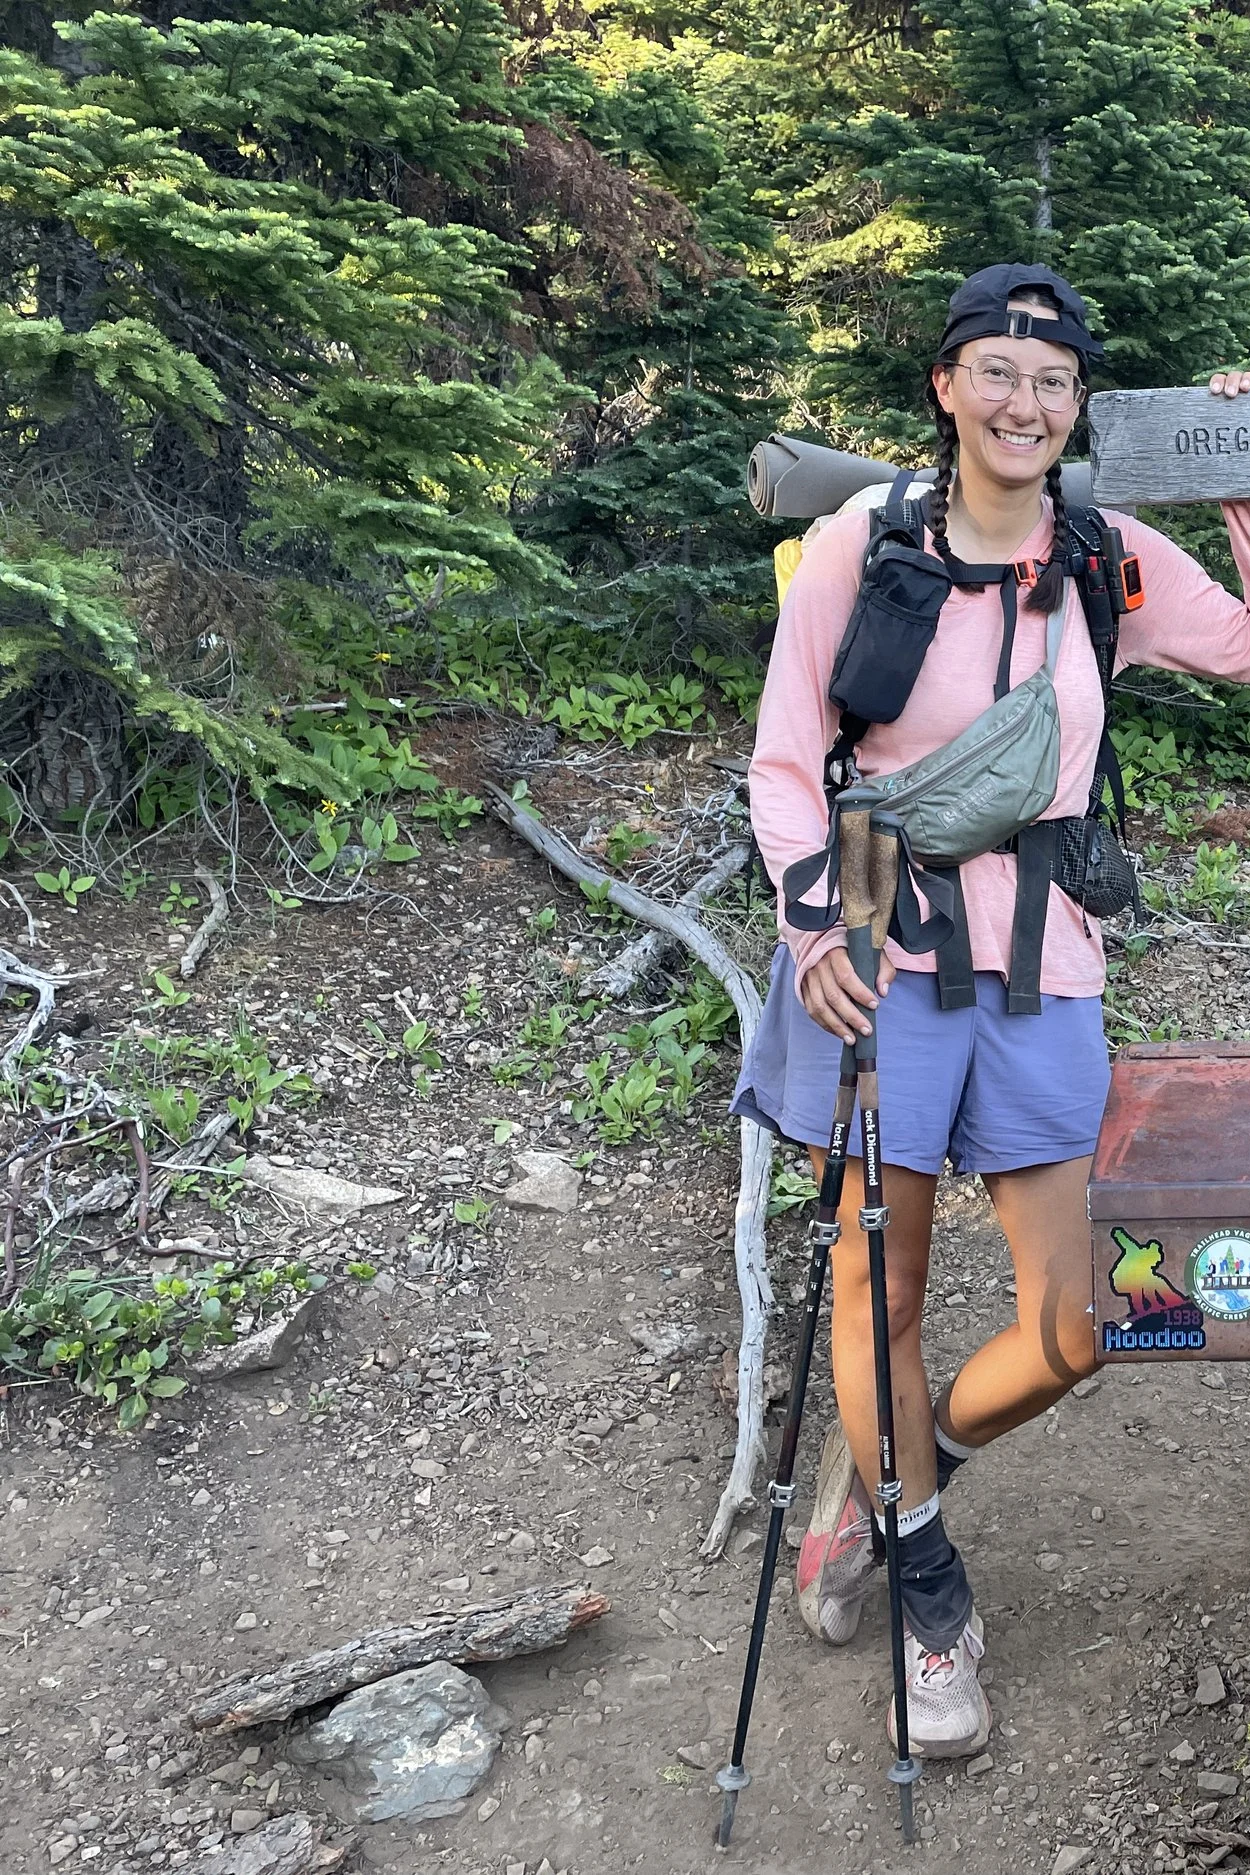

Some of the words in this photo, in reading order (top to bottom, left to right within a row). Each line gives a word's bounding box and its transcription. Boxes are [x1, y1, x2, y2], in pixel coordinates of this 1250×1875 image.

[865, 1110, 875, 1132] ack
[832, 1123, 845, 1148] lack
[866, 1133, 878, 1186] Diamond
[1190, 1229, 1231, 1258] TRAILHEAD
[1164, 1309, 1201, 1326] 1938
[1223, 1312, 1248, 1320] CREST
[1105, 1327, 1203, 1349] Hoodoo
[899, 1504, 931, 1524] njinji
